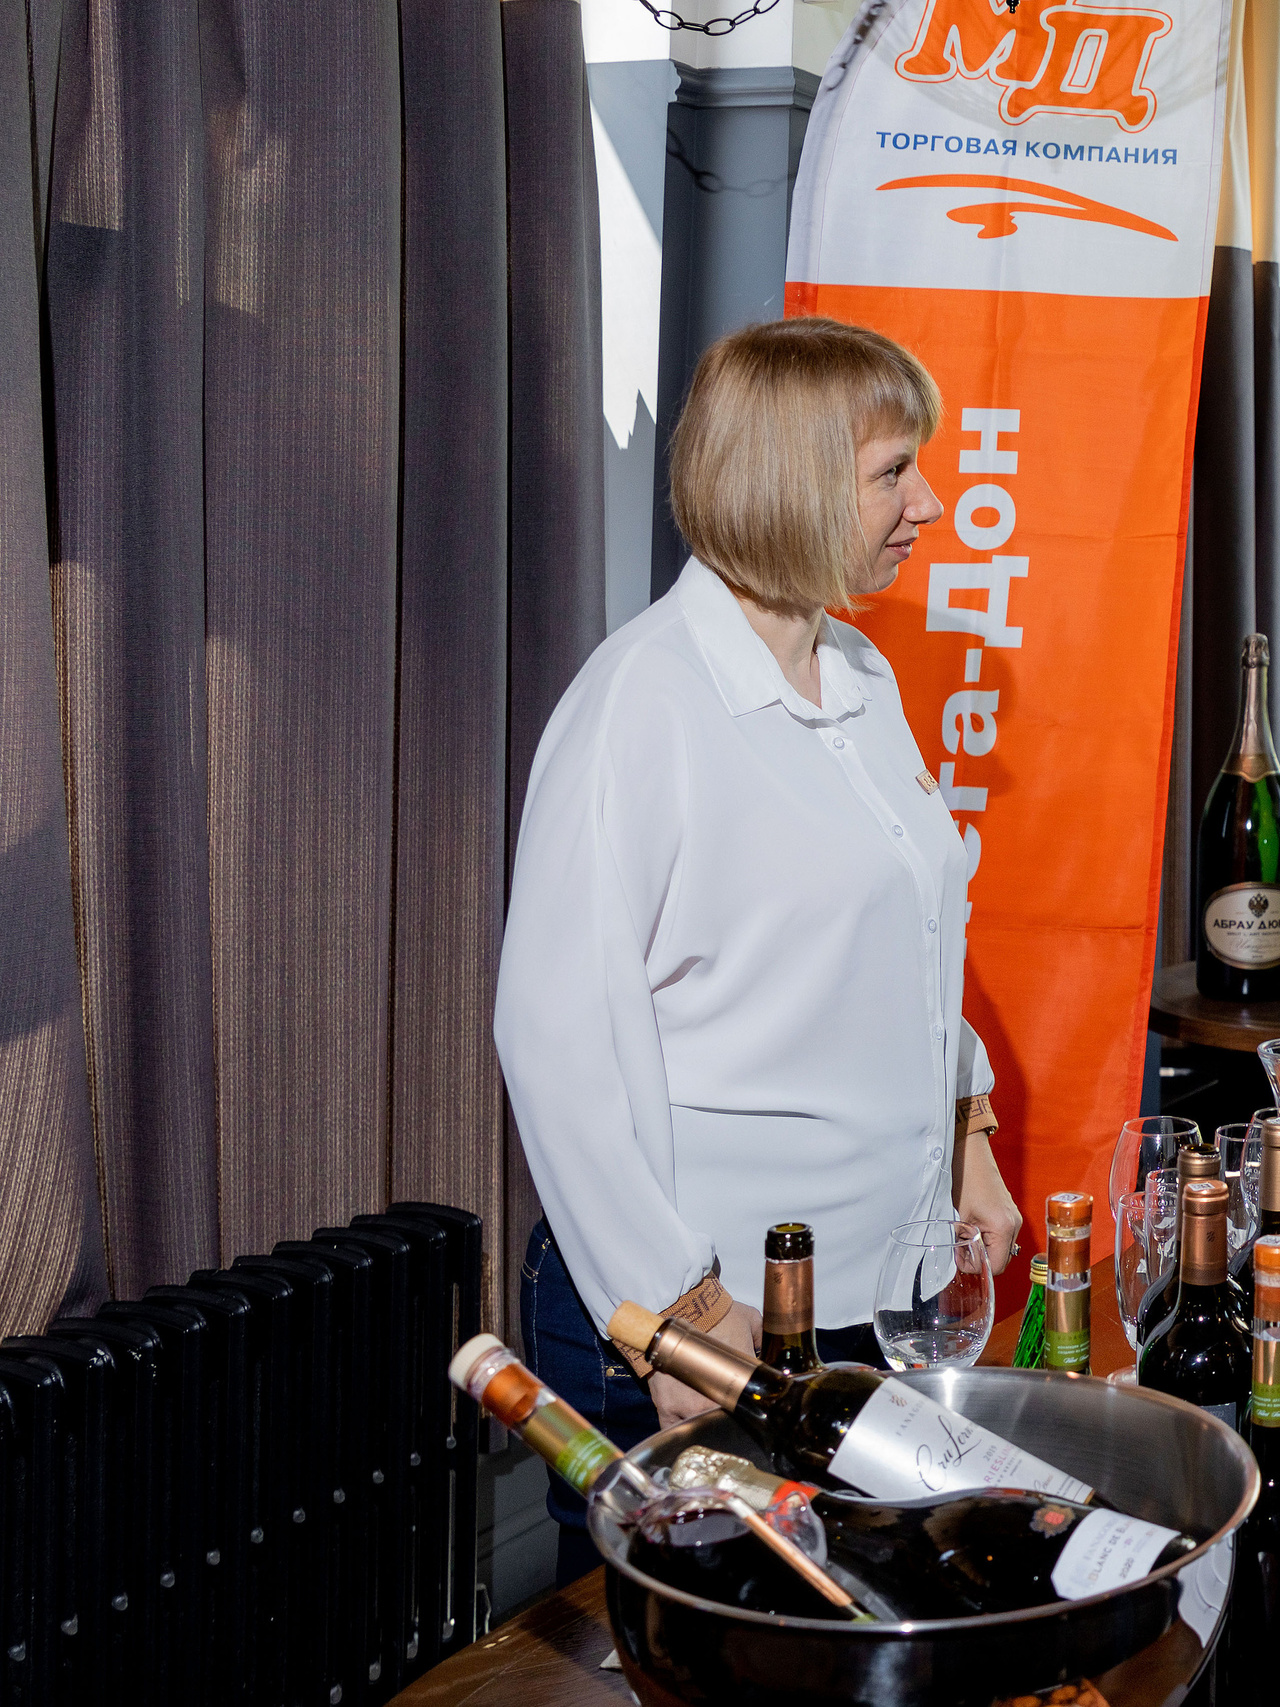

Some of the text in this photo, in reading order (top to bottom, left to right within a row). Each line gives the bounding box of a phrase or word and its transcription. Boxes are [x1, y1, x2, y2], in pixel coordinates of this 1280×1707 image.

[875, 131, 1178, 166] ТОРГОВАЯ КОМПАНИЯ
[925, 407, 1030, 960] га-Дон
[1213, 918, 1255, 930] АБРАУ
